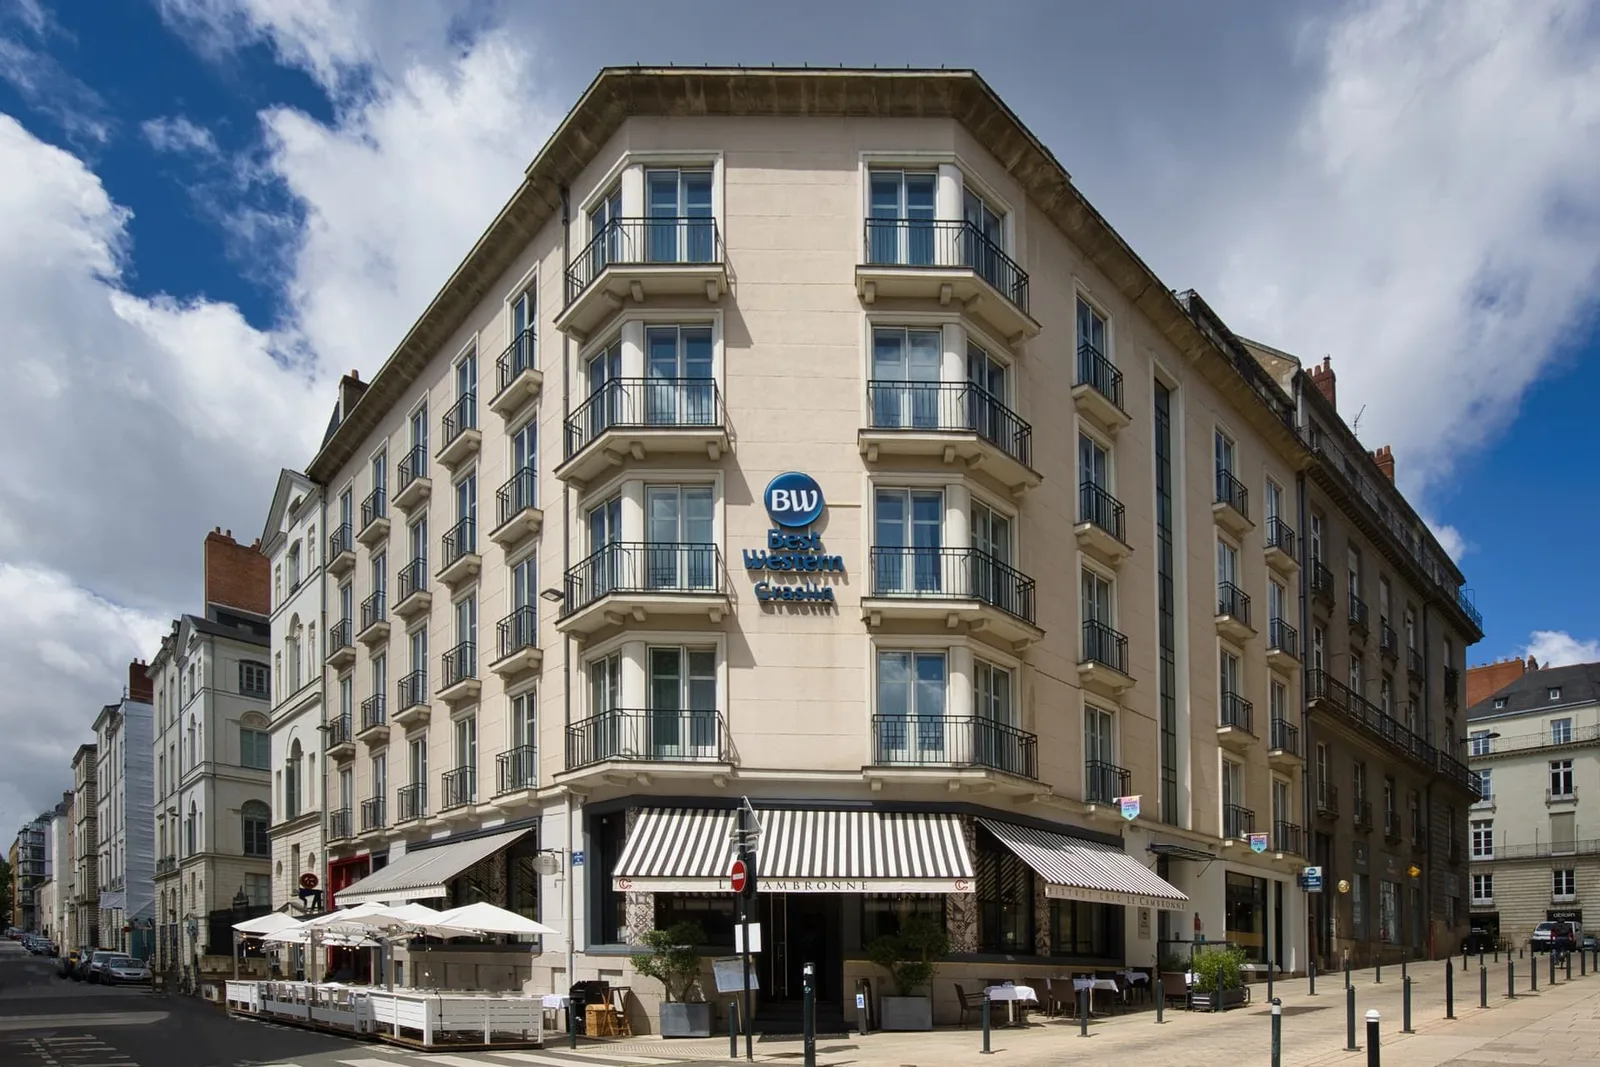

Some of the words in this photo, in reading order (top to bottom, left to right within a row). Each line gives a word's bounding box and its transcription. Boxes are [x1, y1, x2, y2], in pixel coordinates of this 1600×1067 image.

[771, 489, 818, 512] BW
[767, 528, 822, 551] Best
[742, 548, 844, 572] Western
[754, 581, 835, 602] Graslin
[757, 880, 869, 891] AMBRONNE
[1127, 896, 1137, 905] LE
